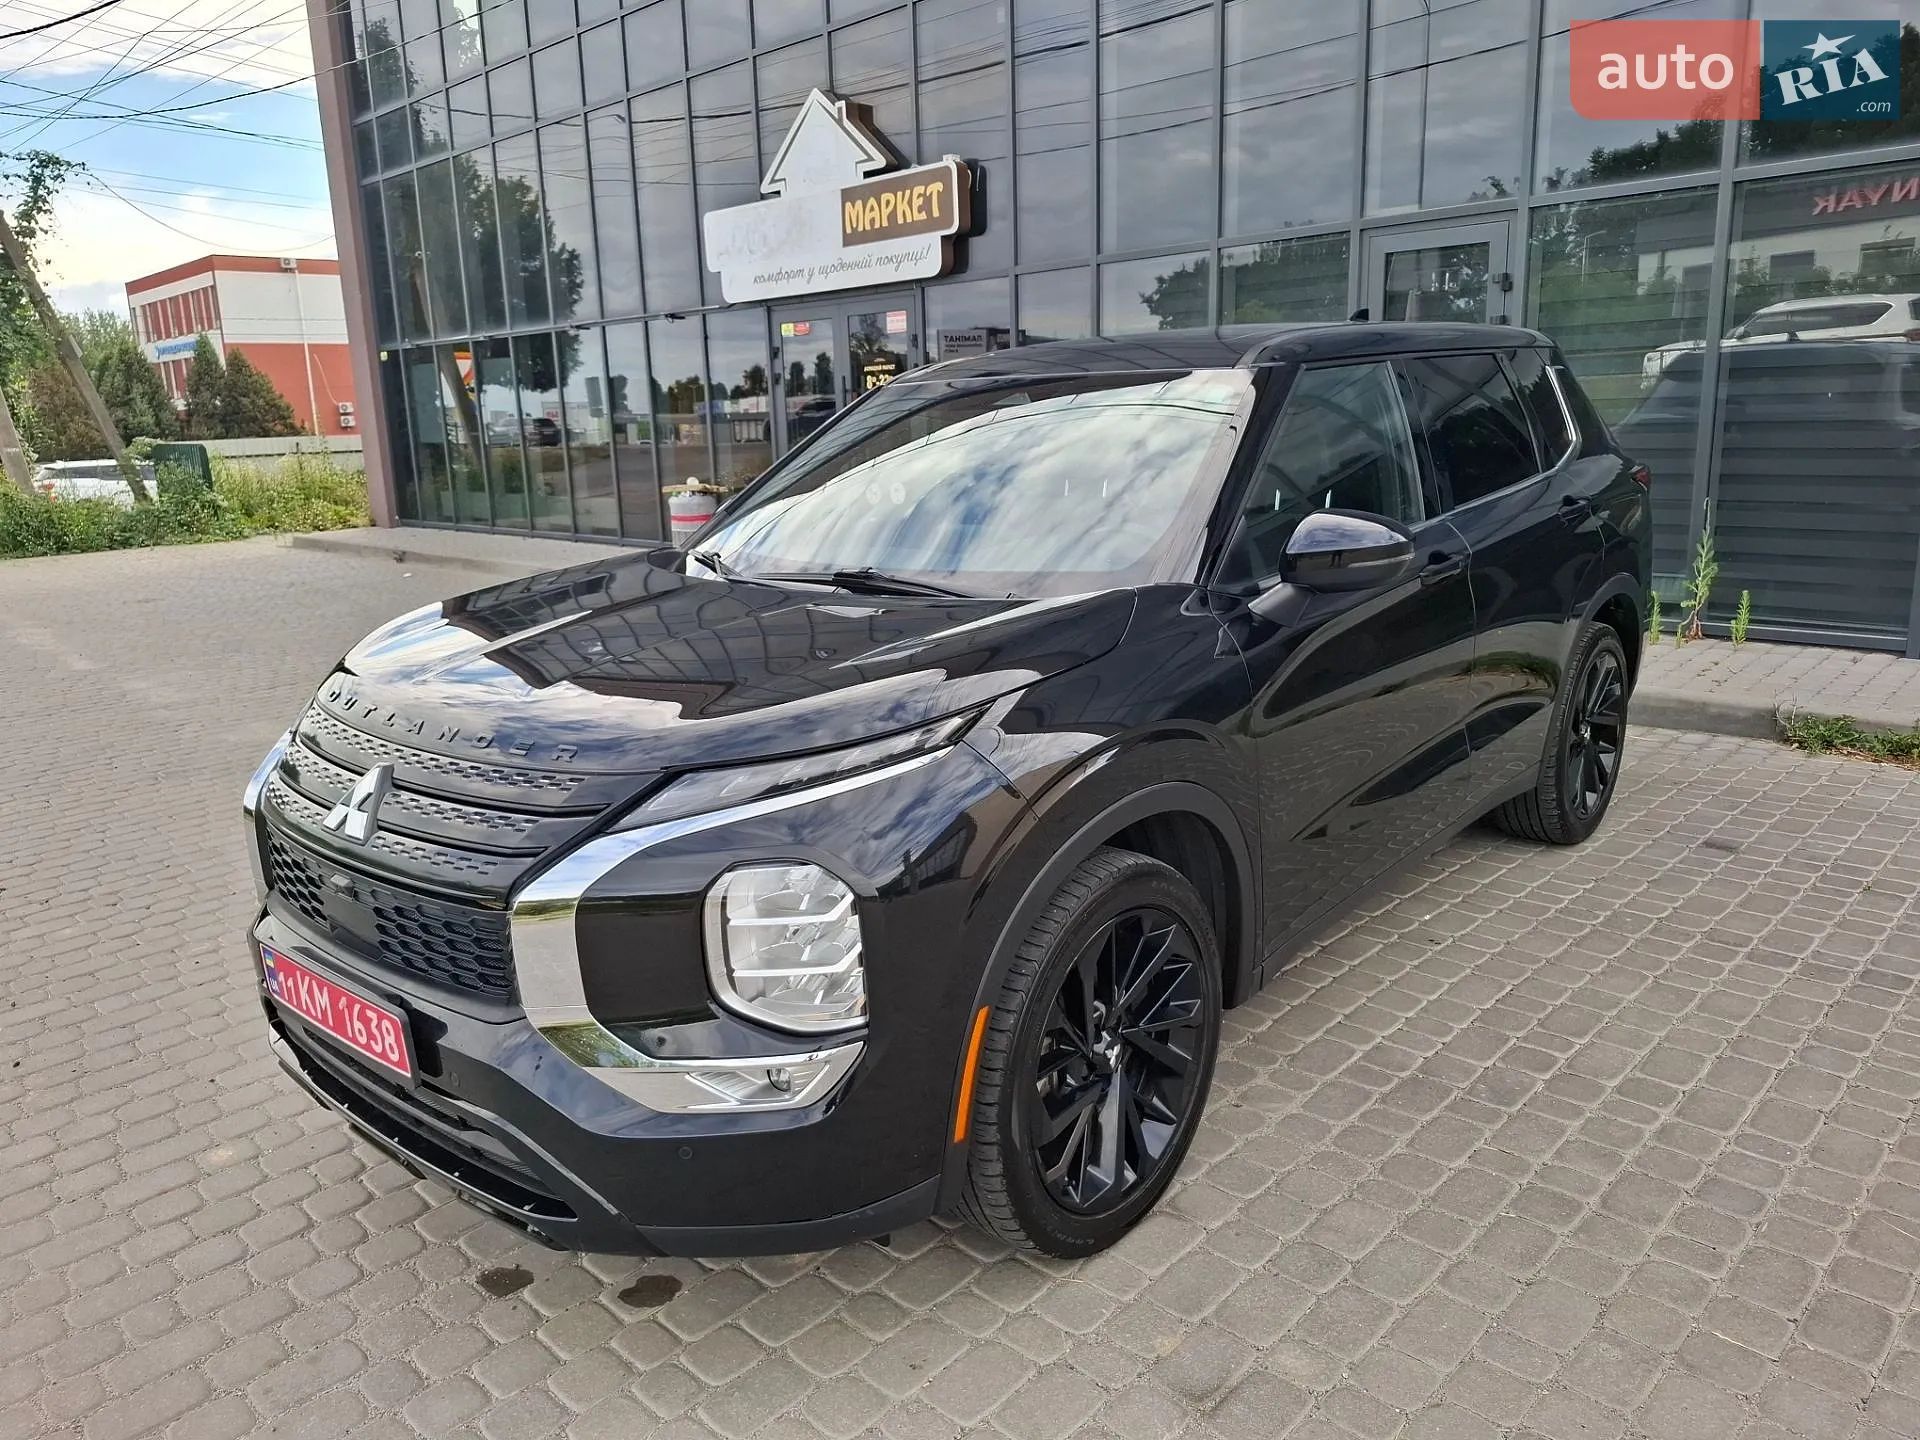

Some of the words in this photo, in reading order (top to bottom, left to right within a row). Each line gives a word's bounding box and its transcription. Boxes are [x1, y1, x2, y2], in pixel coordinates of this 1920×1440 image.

[844, 181, 944, 234] МАРКЕТ
[752, 266, 805, 286] комфорт
[804, 268, 816, 285] у
[817, 254, 874, 280] щоденній
[874, 243, 932, 273] покупці!
[327, 689, 579, 763] OUTLANDER
[338, 996, 400, 1062] 1638
